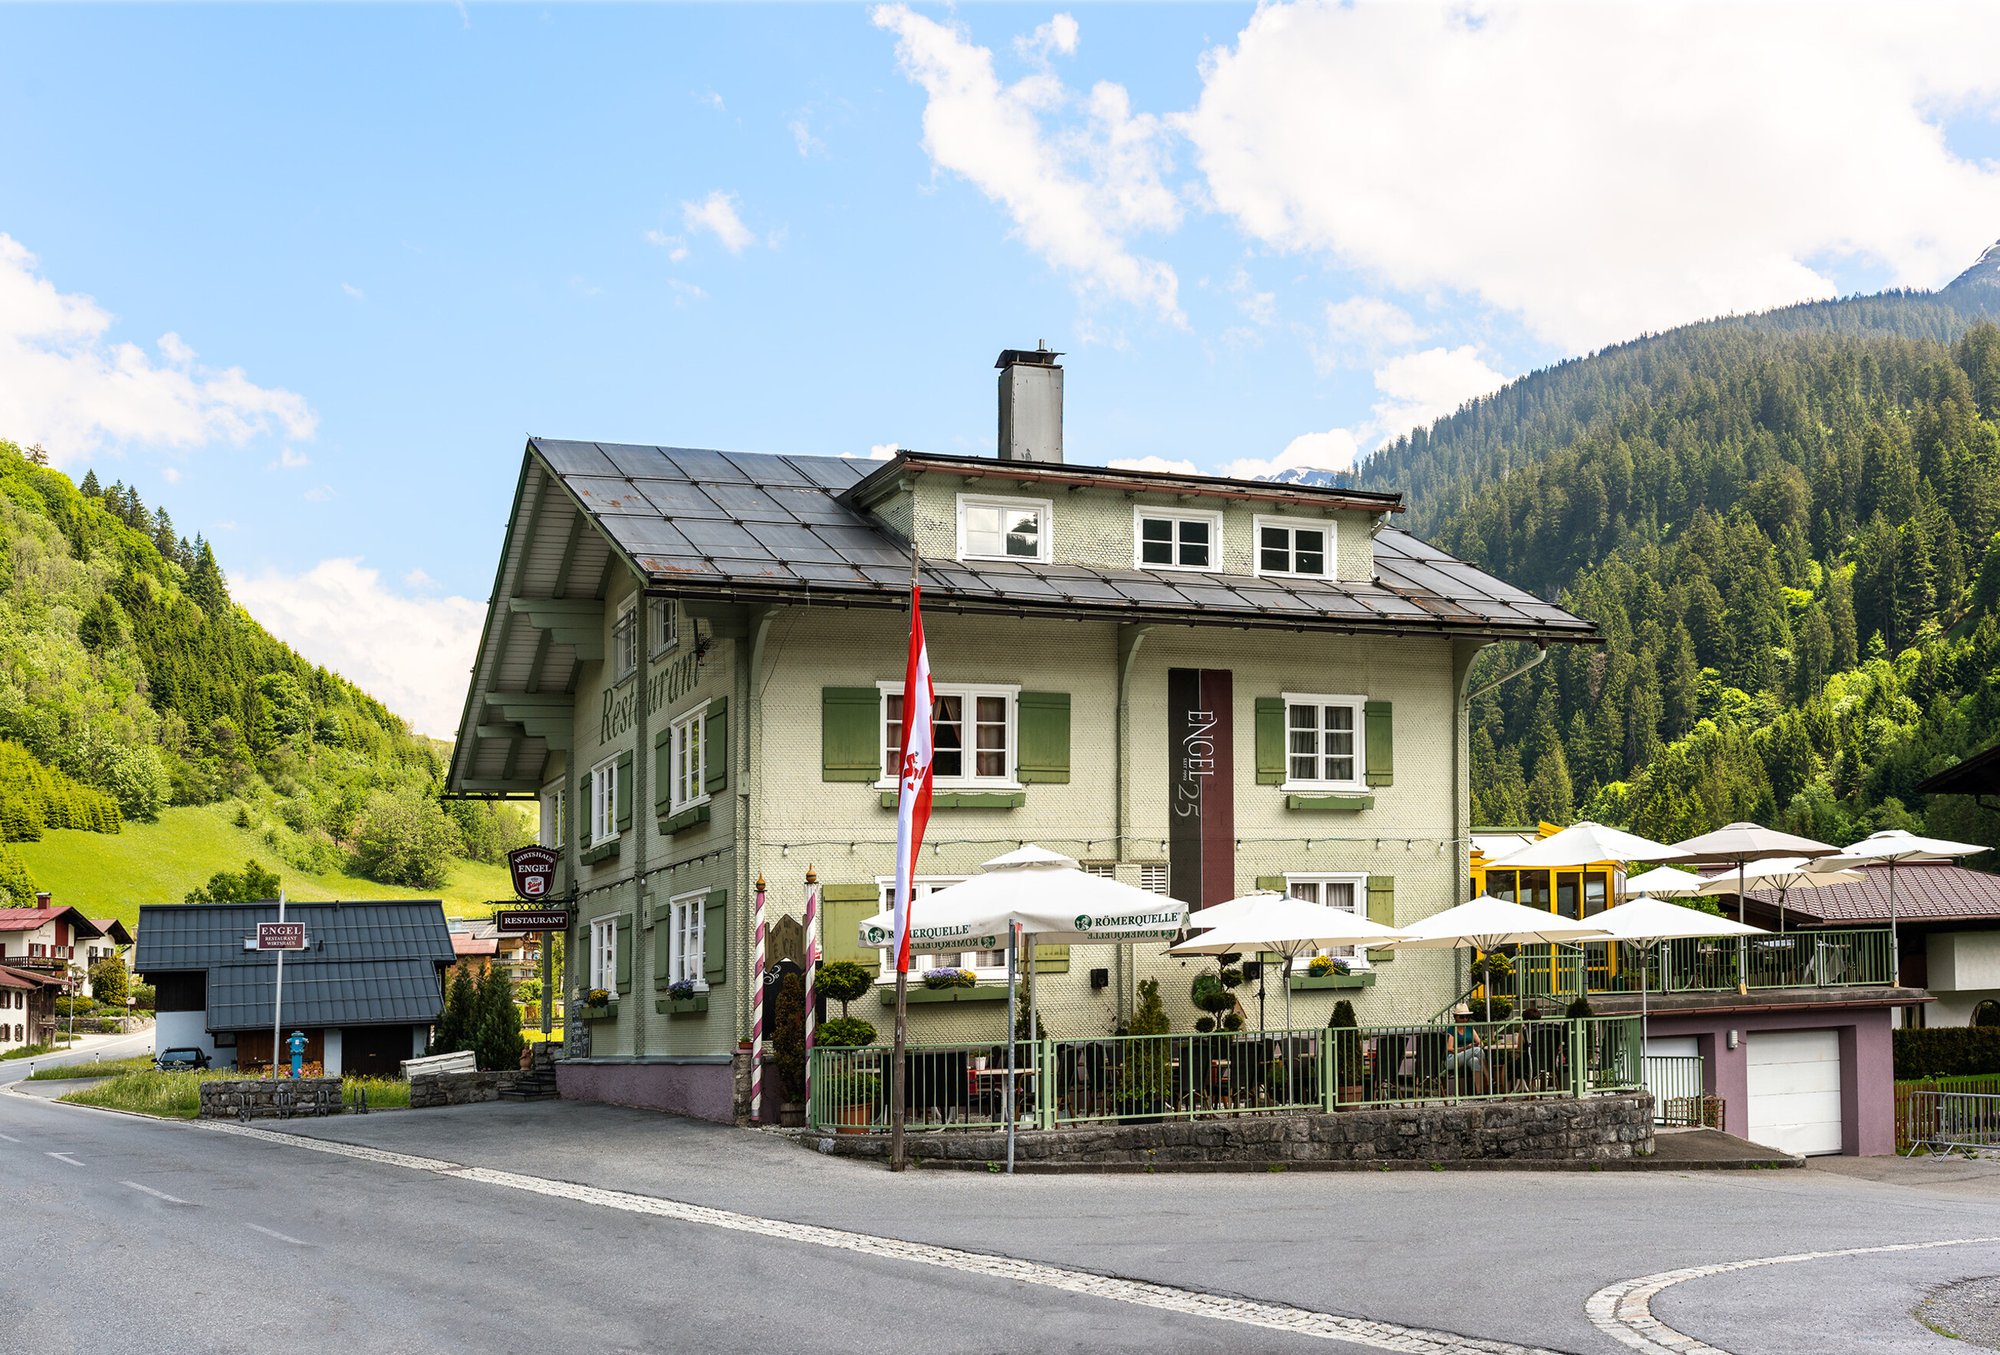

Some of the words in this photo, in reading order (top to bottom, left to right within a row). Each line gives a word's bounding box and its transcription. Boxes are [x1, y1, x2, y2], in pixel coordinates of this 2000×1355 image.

[599, 653, 699, 746] Resturant
[1183, 710, 1218, 781] ENGEL
[1174, 783, 1200, 817] 25
[515, 852, 554, 863] WIRTSHAUS
[518, 864, 551, 873] ENGEL
[504, 916, 565, 924] RESTAURANT
[1095, 912, 1178, 927] RÖMERQUELLE
[261, 926, 301, 935] ENGEL
[888, 925, 969, 939] RERQUELLE
